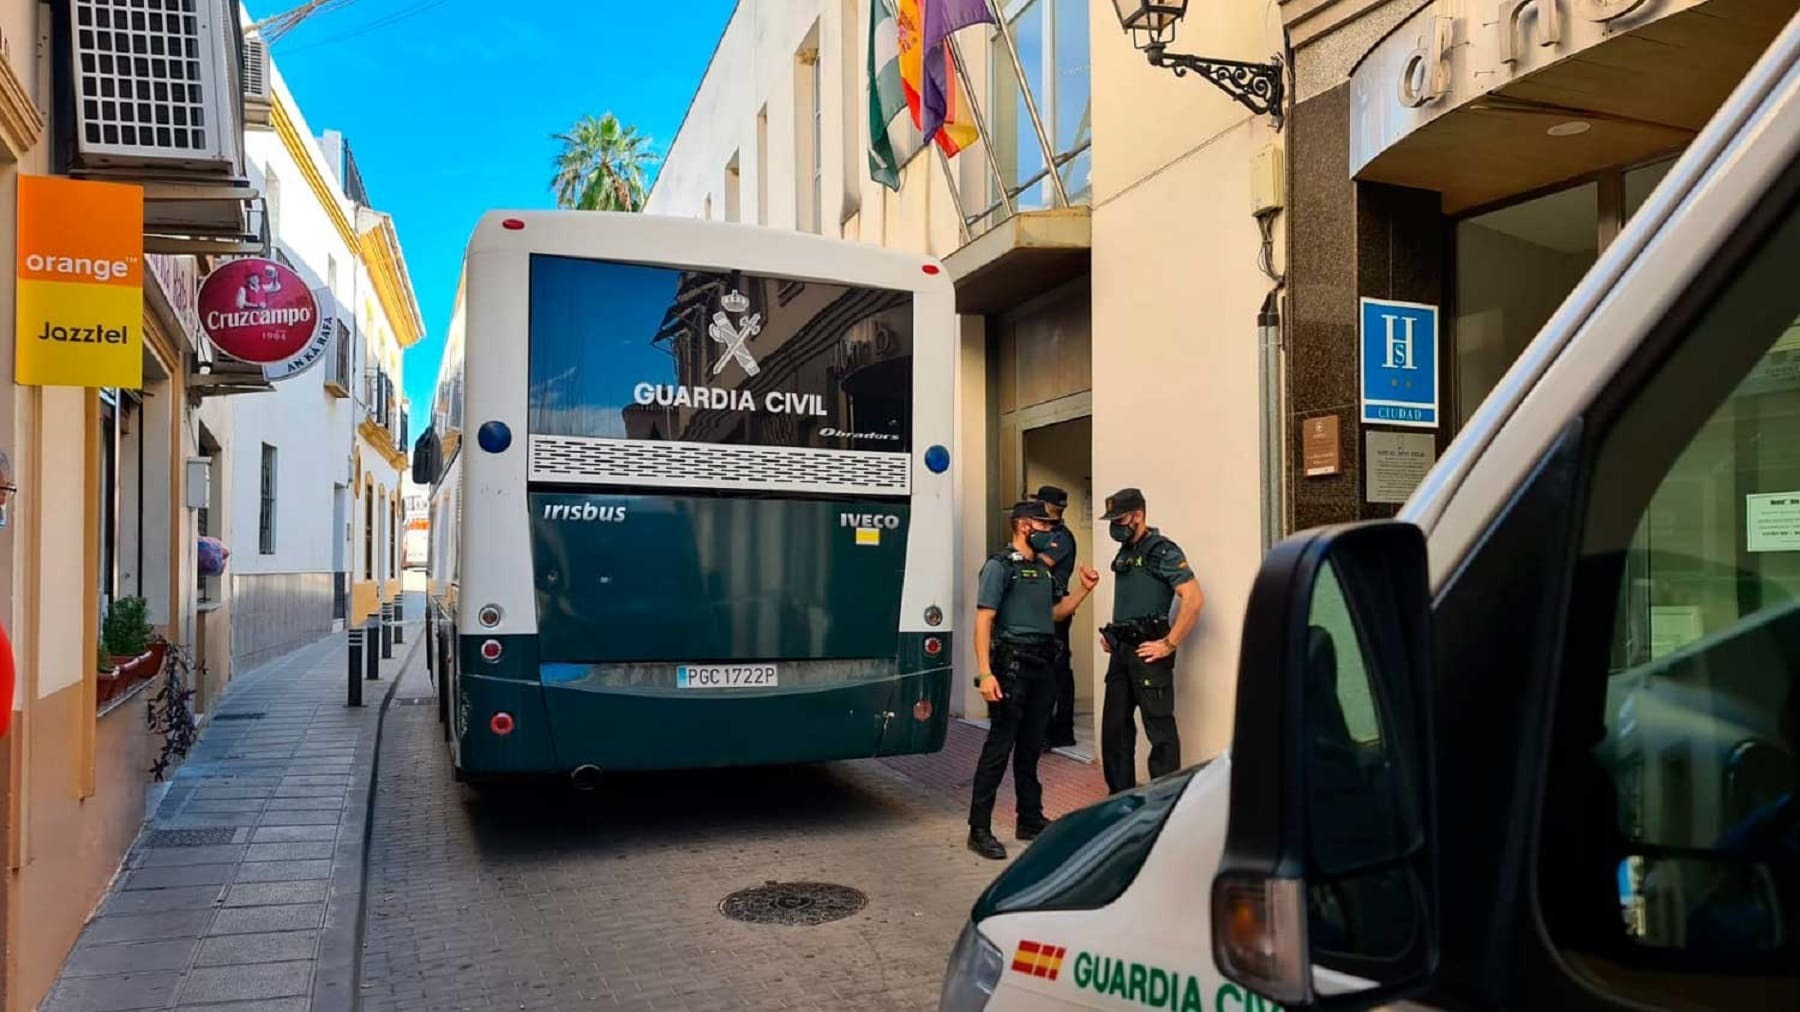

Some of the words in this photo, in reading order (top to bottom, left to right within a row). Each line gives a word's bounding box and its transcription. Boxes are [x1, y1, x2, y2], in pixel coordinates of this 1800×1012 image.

[26, 254, 128, 281] orange
[207, 307, 311, 330] Cruzcampo
[38, 321, 128, 344] Jazztel
[633, 381, 756, 412] GUARDIA
[765, 391, 828, 416] CIVIL
[1378, 408, 1422, 421] CIUDAD
[818, 427, 900, 440] Obradors
[840, 512, 900, 529] IVECO
[688, 668, 720, 685] PGC
[724, 667, 775, 685] 1722P
[1074, 951, 1202, 1012] GUARDIA
